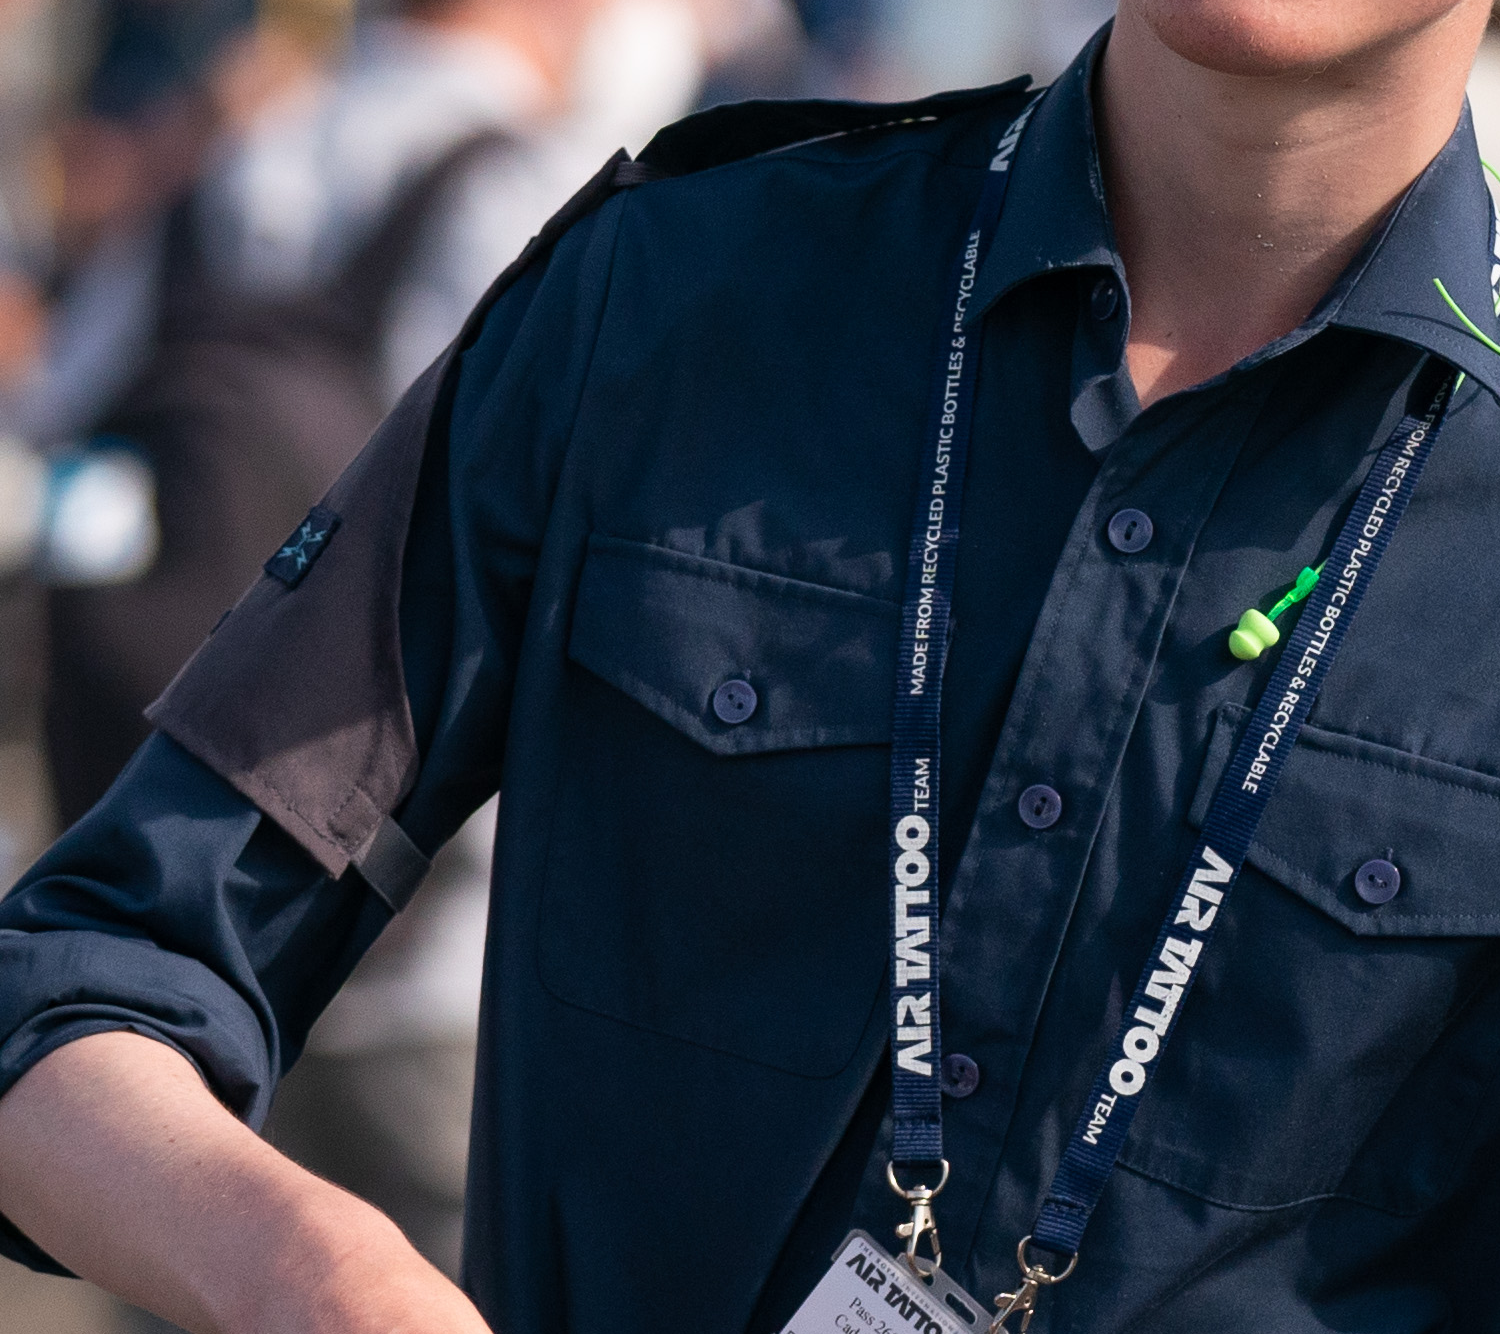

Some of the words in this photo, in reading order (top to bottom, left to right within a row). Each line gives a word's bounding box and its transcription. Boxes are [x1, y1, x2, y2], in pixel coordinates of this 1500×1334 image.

[952, 336, 966, 348] &
[941, 351, 964, 424] BOTTLES
[932, 427, 954, 495] PLASTIC
[1402, 413, 1436, 457] FROM
[1363, 456, 1412, 539] RECYCLED
[921, 498, 945, 585] RECYCLED
[1331, 539, 1372, 606] PLASTIC
[915, 588, 935, 640] FROM
[1297, 605, 1342, 677] BOTTLES
[910, 641, 929, 696] MADE
[1289, 676, 1306, 690] &
[1242, 691, 1300, 794] RECYCLABLE
[914, 757, 931, 812] TEAM
[894, 814, 931, 988] TATTOO
[1174, 845, 1234, 932] AIR
[896, 991, 932, 1077] AIR
[1109, 936, 1204, 1096] TATTOO
[1082, 1093, 1118, 1145] TEAM
[845, 1252, 887, 1294] AIR
[849, 1297, 876, 1327] Pass
